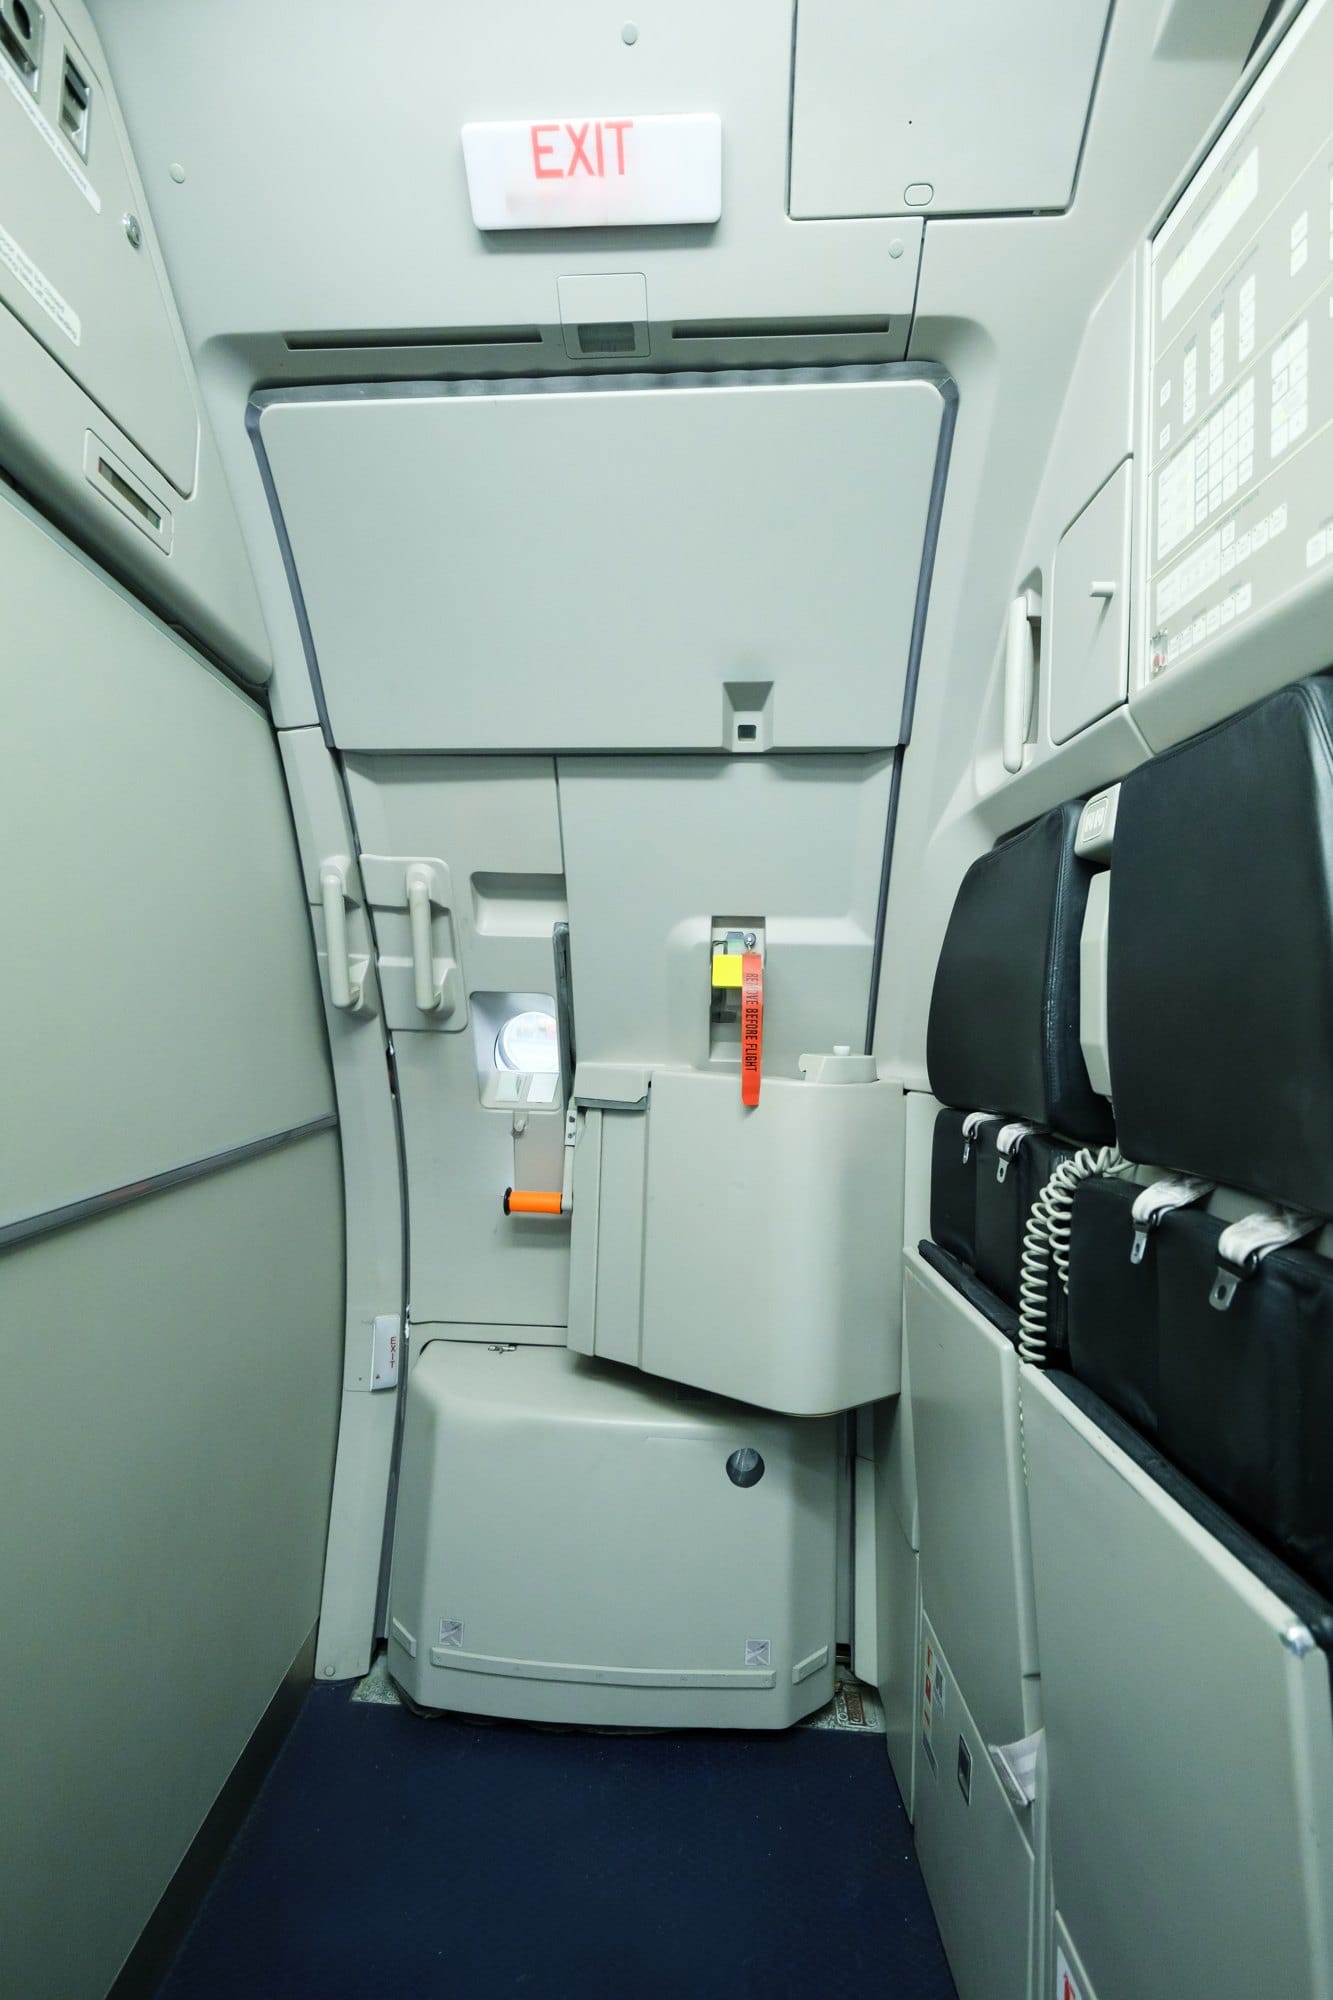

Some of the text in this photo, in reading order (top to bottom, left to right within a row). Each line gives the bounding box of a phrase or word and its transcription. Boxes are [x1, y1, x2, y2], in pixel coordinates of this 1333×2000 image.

[530, 121, 634, 179] EXIT
[745, 1008, 758, 1040] BEFORE
[745, 1043, 757, 1072] FLIGHT
